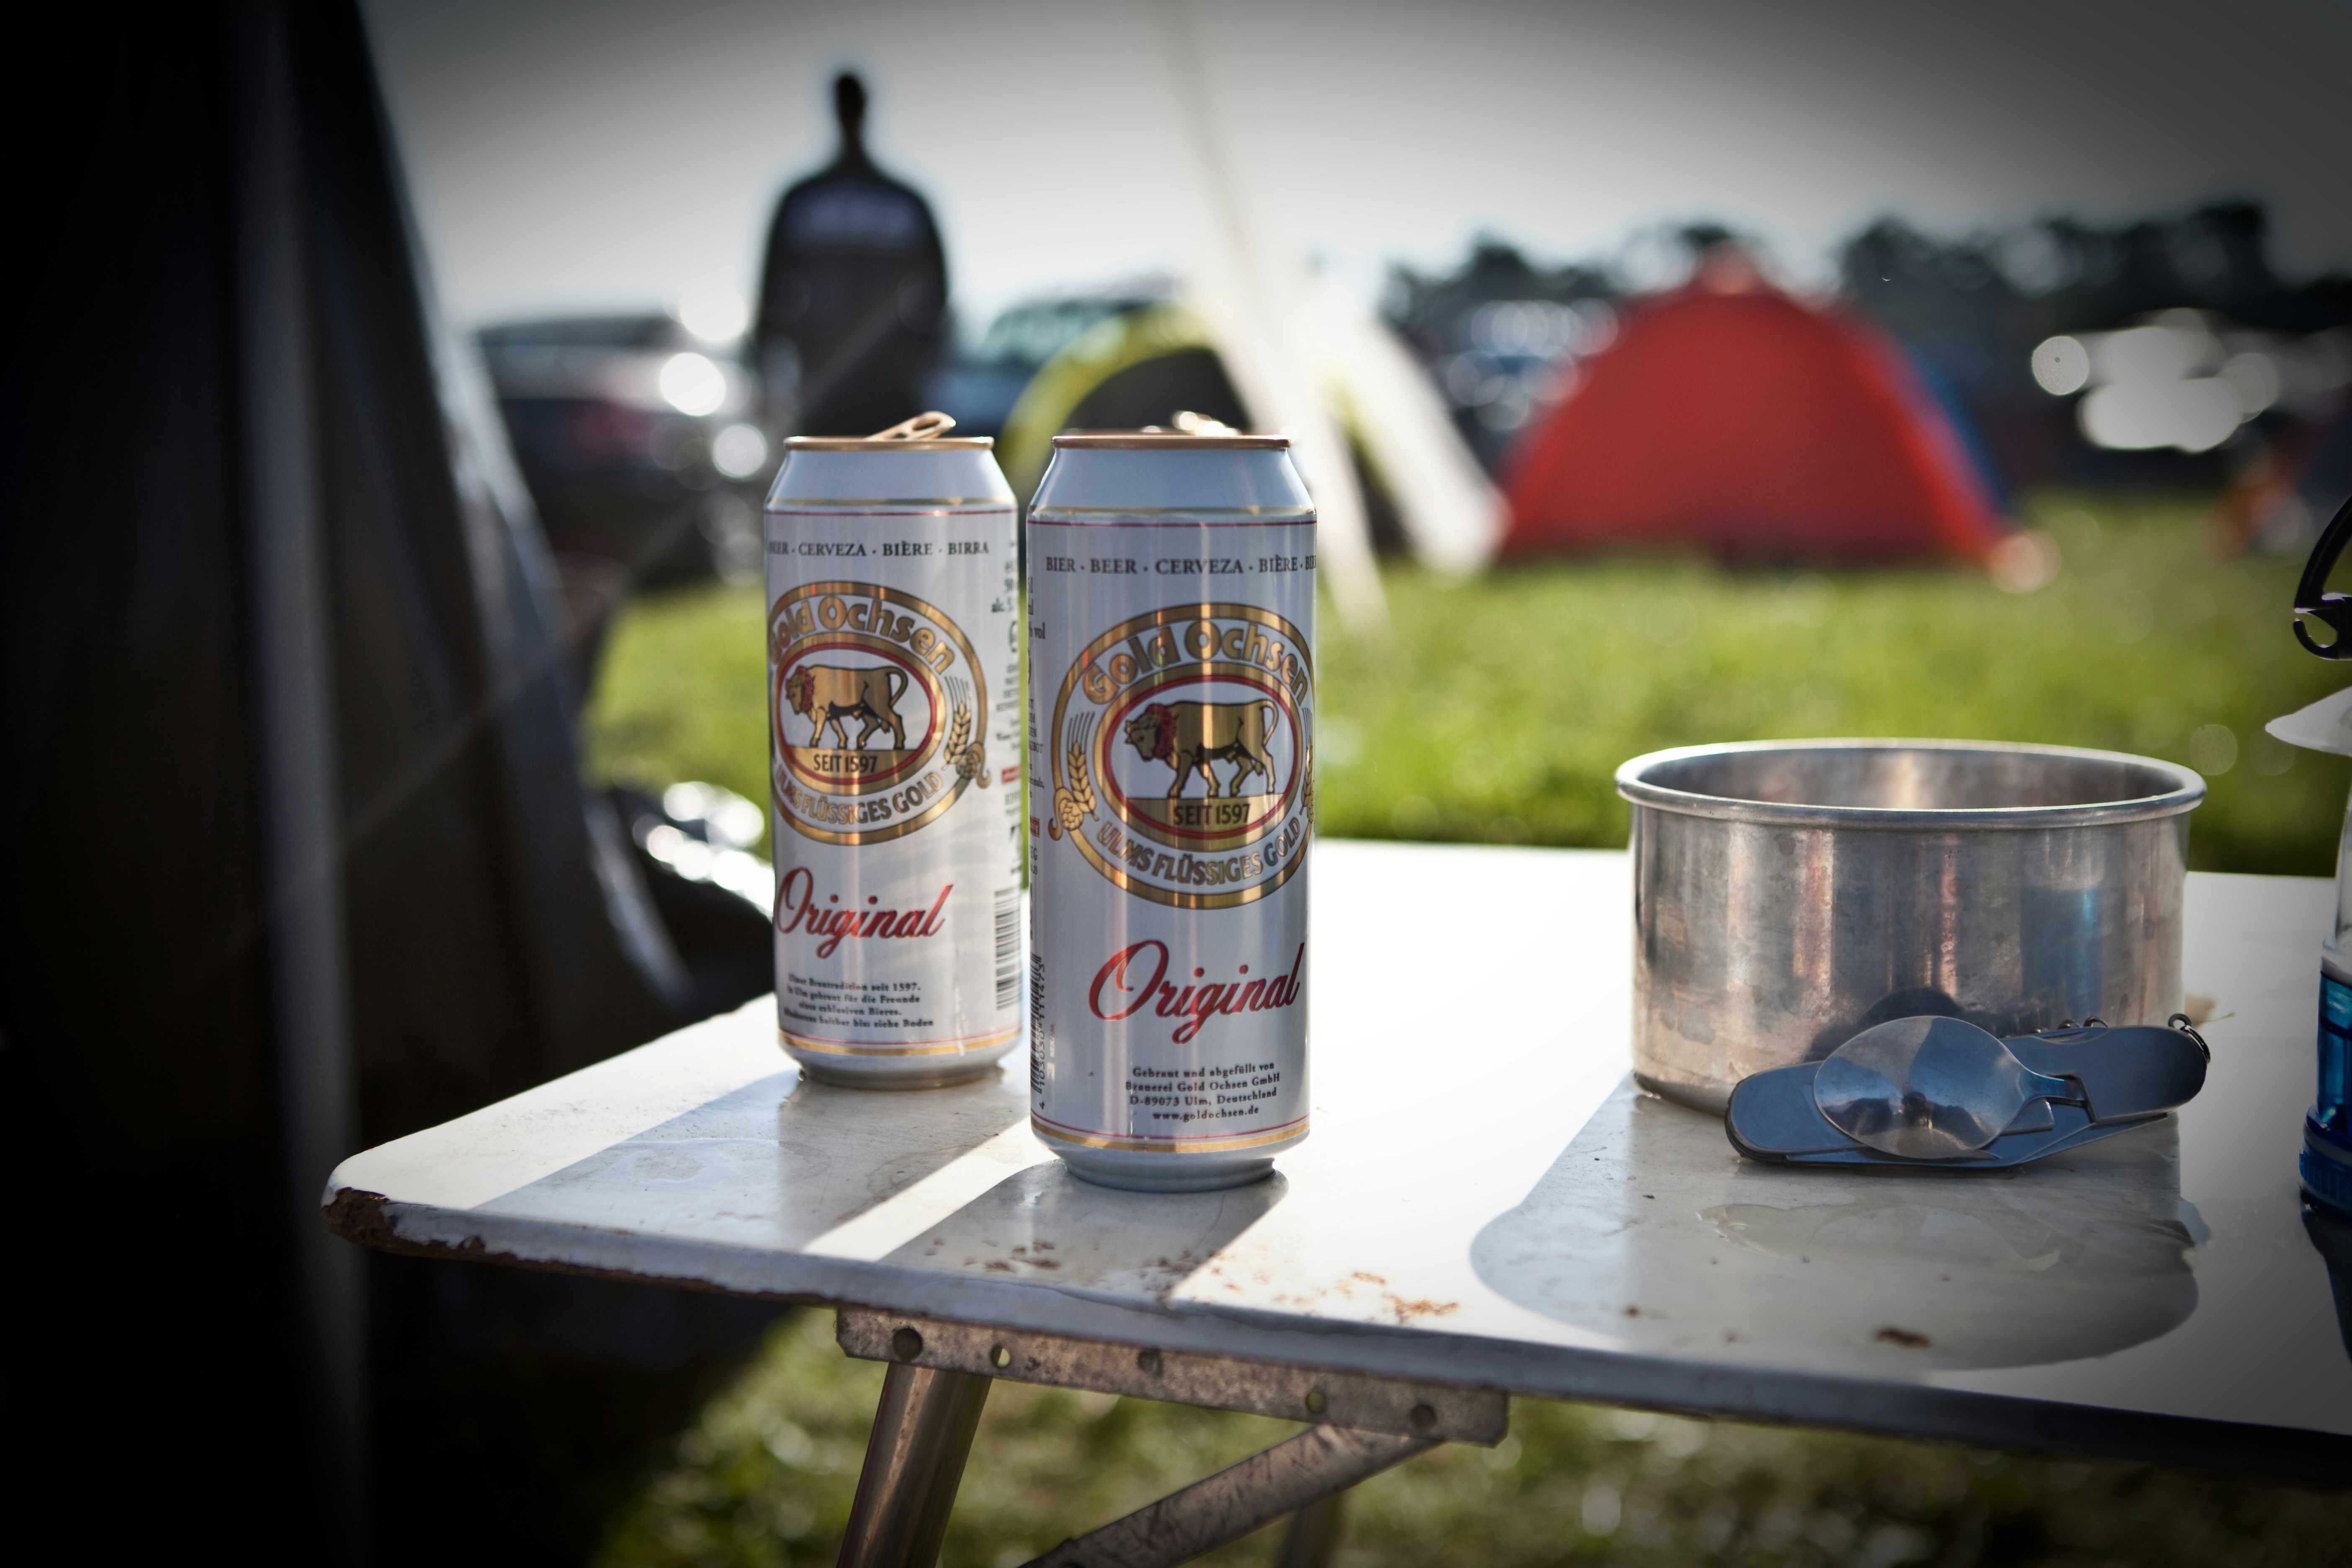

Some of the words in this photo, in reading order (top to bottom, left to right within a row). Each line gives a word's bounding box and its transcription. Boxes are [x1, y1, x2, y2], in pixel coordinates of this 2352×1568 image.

[798, 542, 866, 557] CERVEZA
[882, 540, 933, 556] BIÈRE
[948, 542, 989, 555] BIRRA
[1046, 557, 1075, 572] BIER
[1090, 559, 1137, 575] BEER
[1155, 559, 1243, 575] CERVEZA
[1259, 554, 1297, 573] BIÈRE
[818, 596, 955, 673] Ochsen
[1034, 622, 1046, 640] vol
[1083, 626, 1181, 704] Gold
[1185, 619, 1308, 706] Ochsen
[814, 754, 841, 772] SEIT
[845, 755, 878, 773] 1597
[775, 765, 802, 808] ULMS
[802, 796, 892, 824] FLÜSSIGES
[893, 772, 943, 813] GOLD
[1173, 804, 1212, 826] SEIT
[1216, 803, 1251, 825] 1597
[1096, 821, 1154, 872] ULMS
[1152, 852, 1264, 885] FLÜSSIGES
[1264, 817, 1301, 867] GOLD
[776, 867, 954, 959] Original
[871, 983, 889, 992] seit
[893, 982, 921, 992] 1597.
[1089, 940, 1305, 1044] Original
[810, 992, 841, 1001] gebraut
[844, 994, 858, 1003] für
[861, 995, 876, 1003] die
[880, 994, 920, 1003] Freunde
[818, 1005, 864, 1015] exklusiven
[868, 1006, 902, 1016] Bieres.
[819, 1016, 850, 1025] haltbar
[874, 1019, 899, 1028] siehe
[903, 1018, 934, 1027] Boden
[1132, 1067, 1179, 1078] Gebraut
[1184, 1068, 1205, 1078] und
[1209, 1064, 1256, 1078] abgefüllt
[1259, 1062, 1274, 1071] von
[1125, 1081, 1173, 1092] Brauerei
[1177, 1081, 1205, 1092] Gold
[1210, 1081, 1248, 1091] Ochsen
[1252, 1073, 1280, 1086] GmbH
[1130, 1096, 1180, 1107] D-89073
[1184, 1096, 1212, 1106] Ulm,
[1217, 1087, 1277, 1105] Deutschland
[1153, 1104, 1259, 1123] www.goldochsen.de
